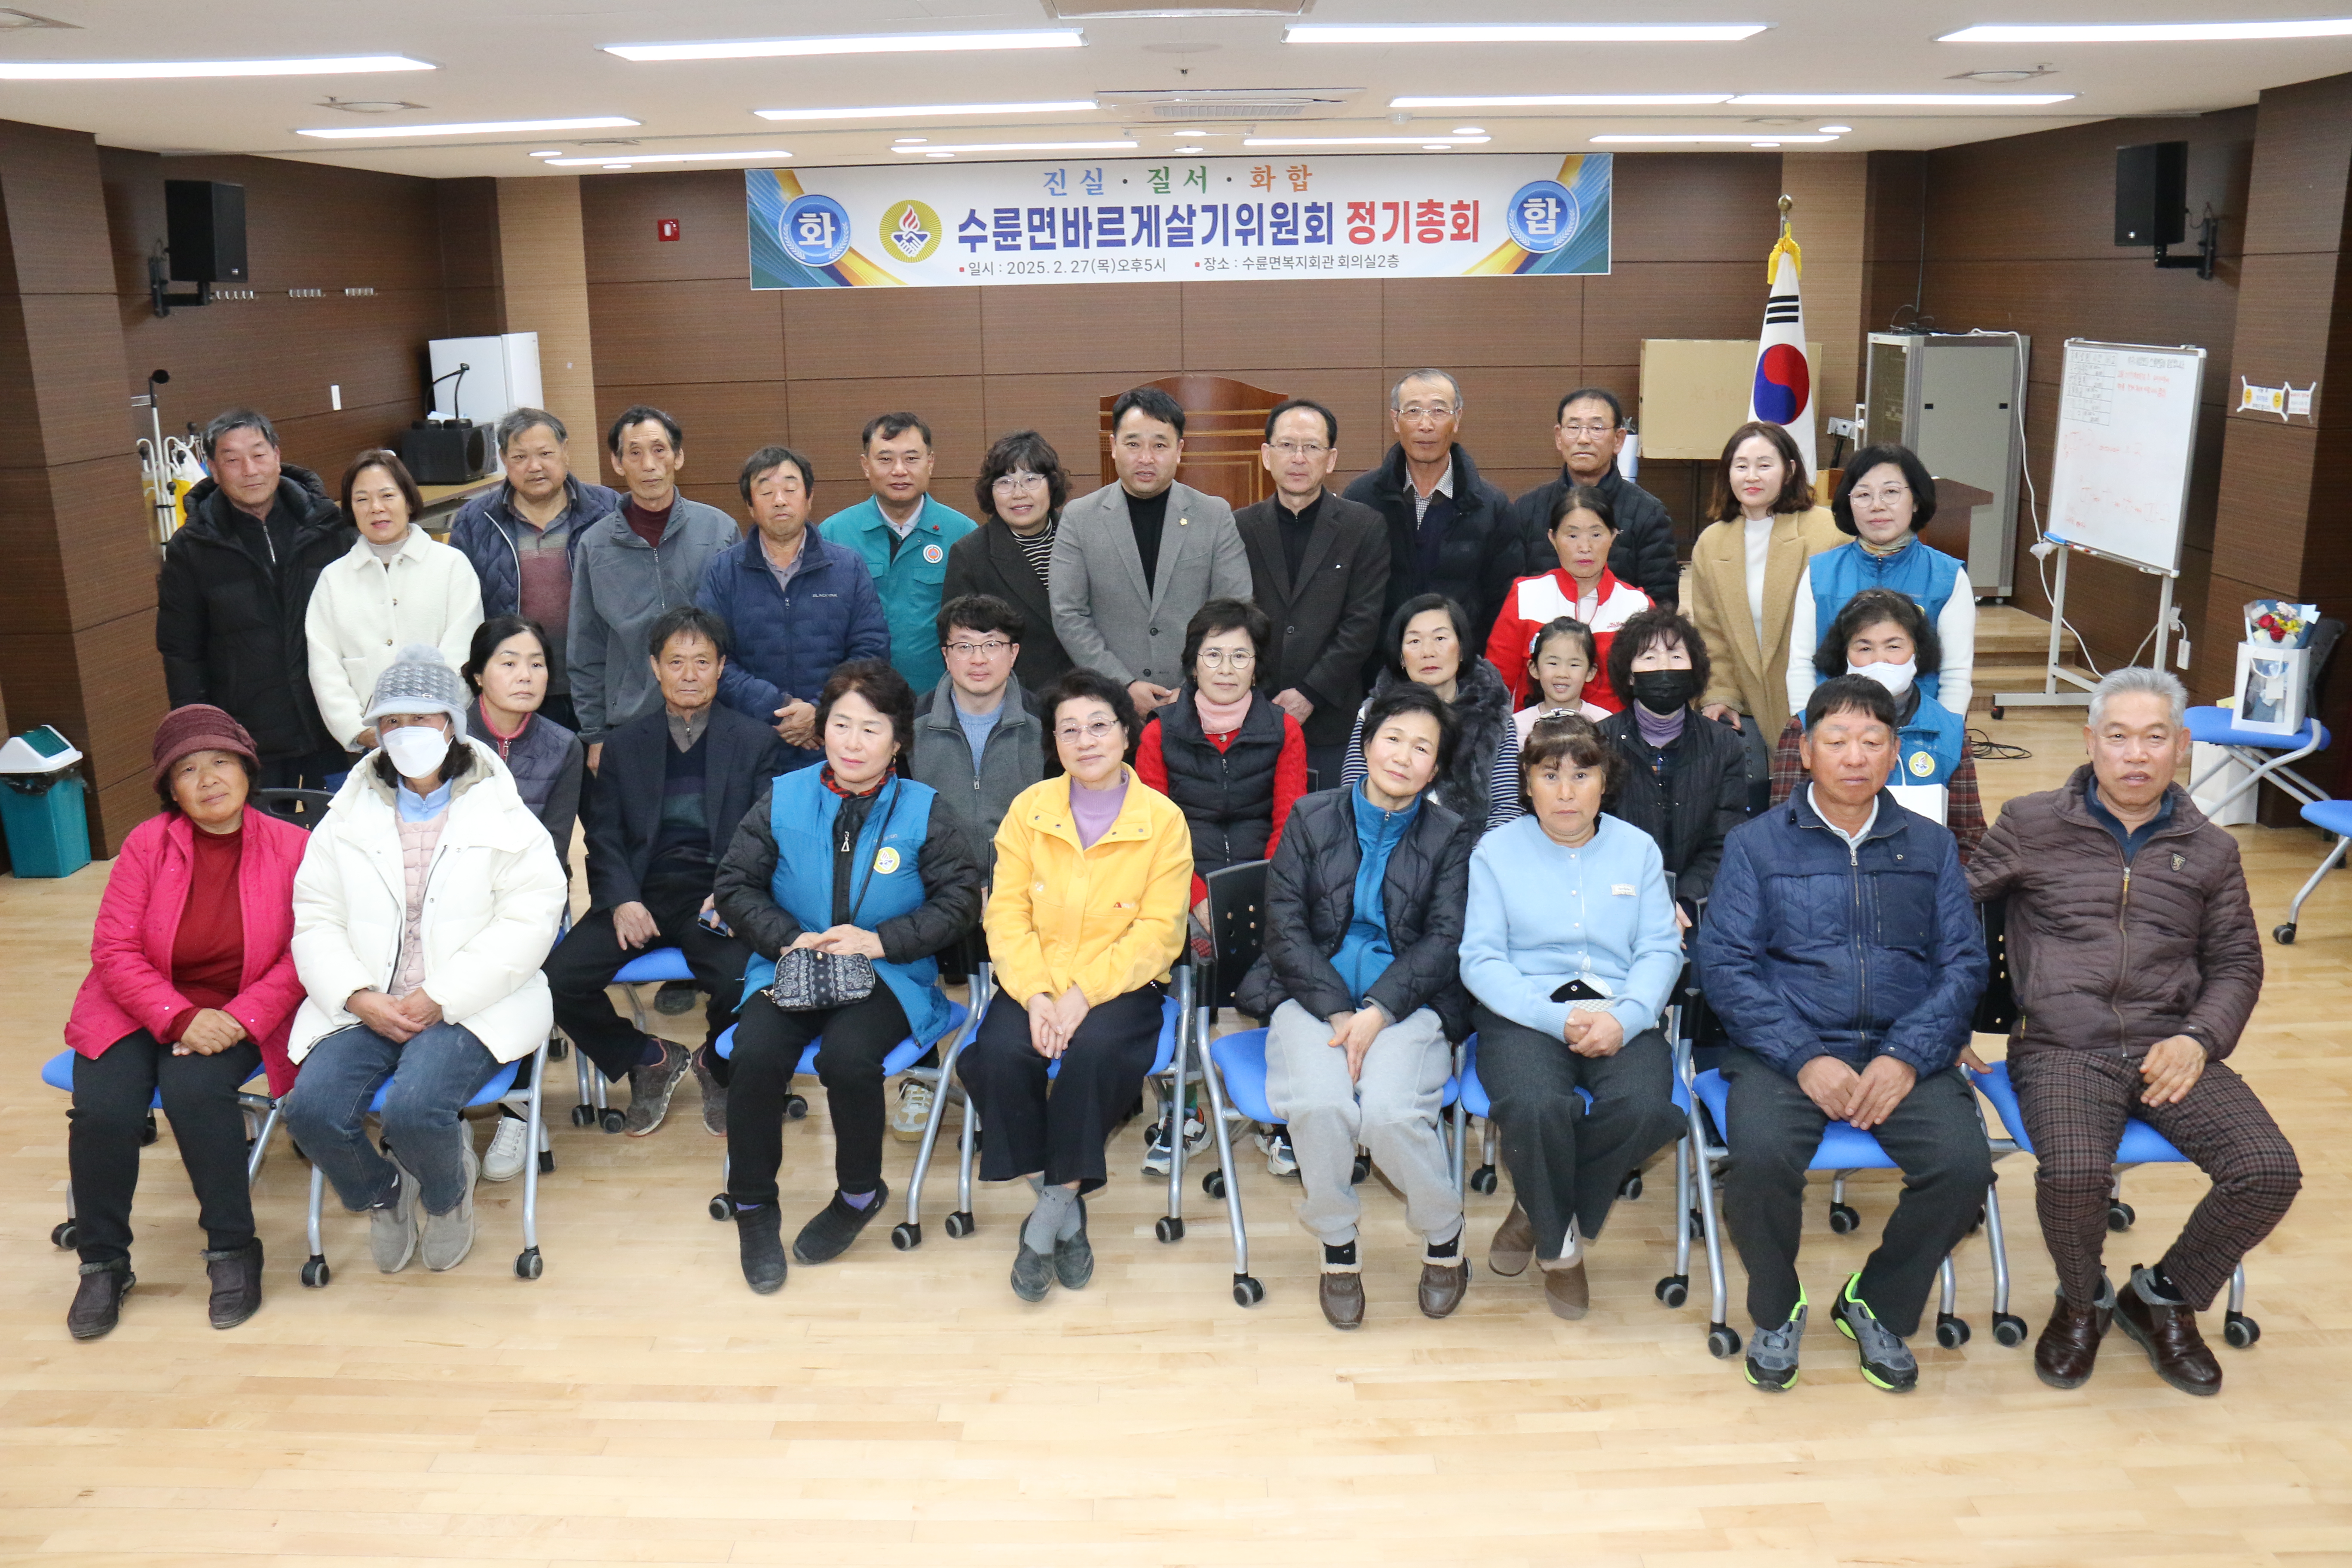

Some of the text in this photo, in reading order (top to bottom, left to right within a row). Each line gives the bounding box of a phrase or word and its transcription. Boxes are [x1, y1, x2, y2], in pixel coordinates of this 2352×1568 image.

[798, 212, 836, 248] 화
[958, 199, 1479, 253] 수륜면바르게살기위원회 정기총회
[1523, 197, 1561, 235] 합
[1242, 255, 1334, 270] 수륜면복지회관
[1338, 254, 1400, 269] 회의실2층
